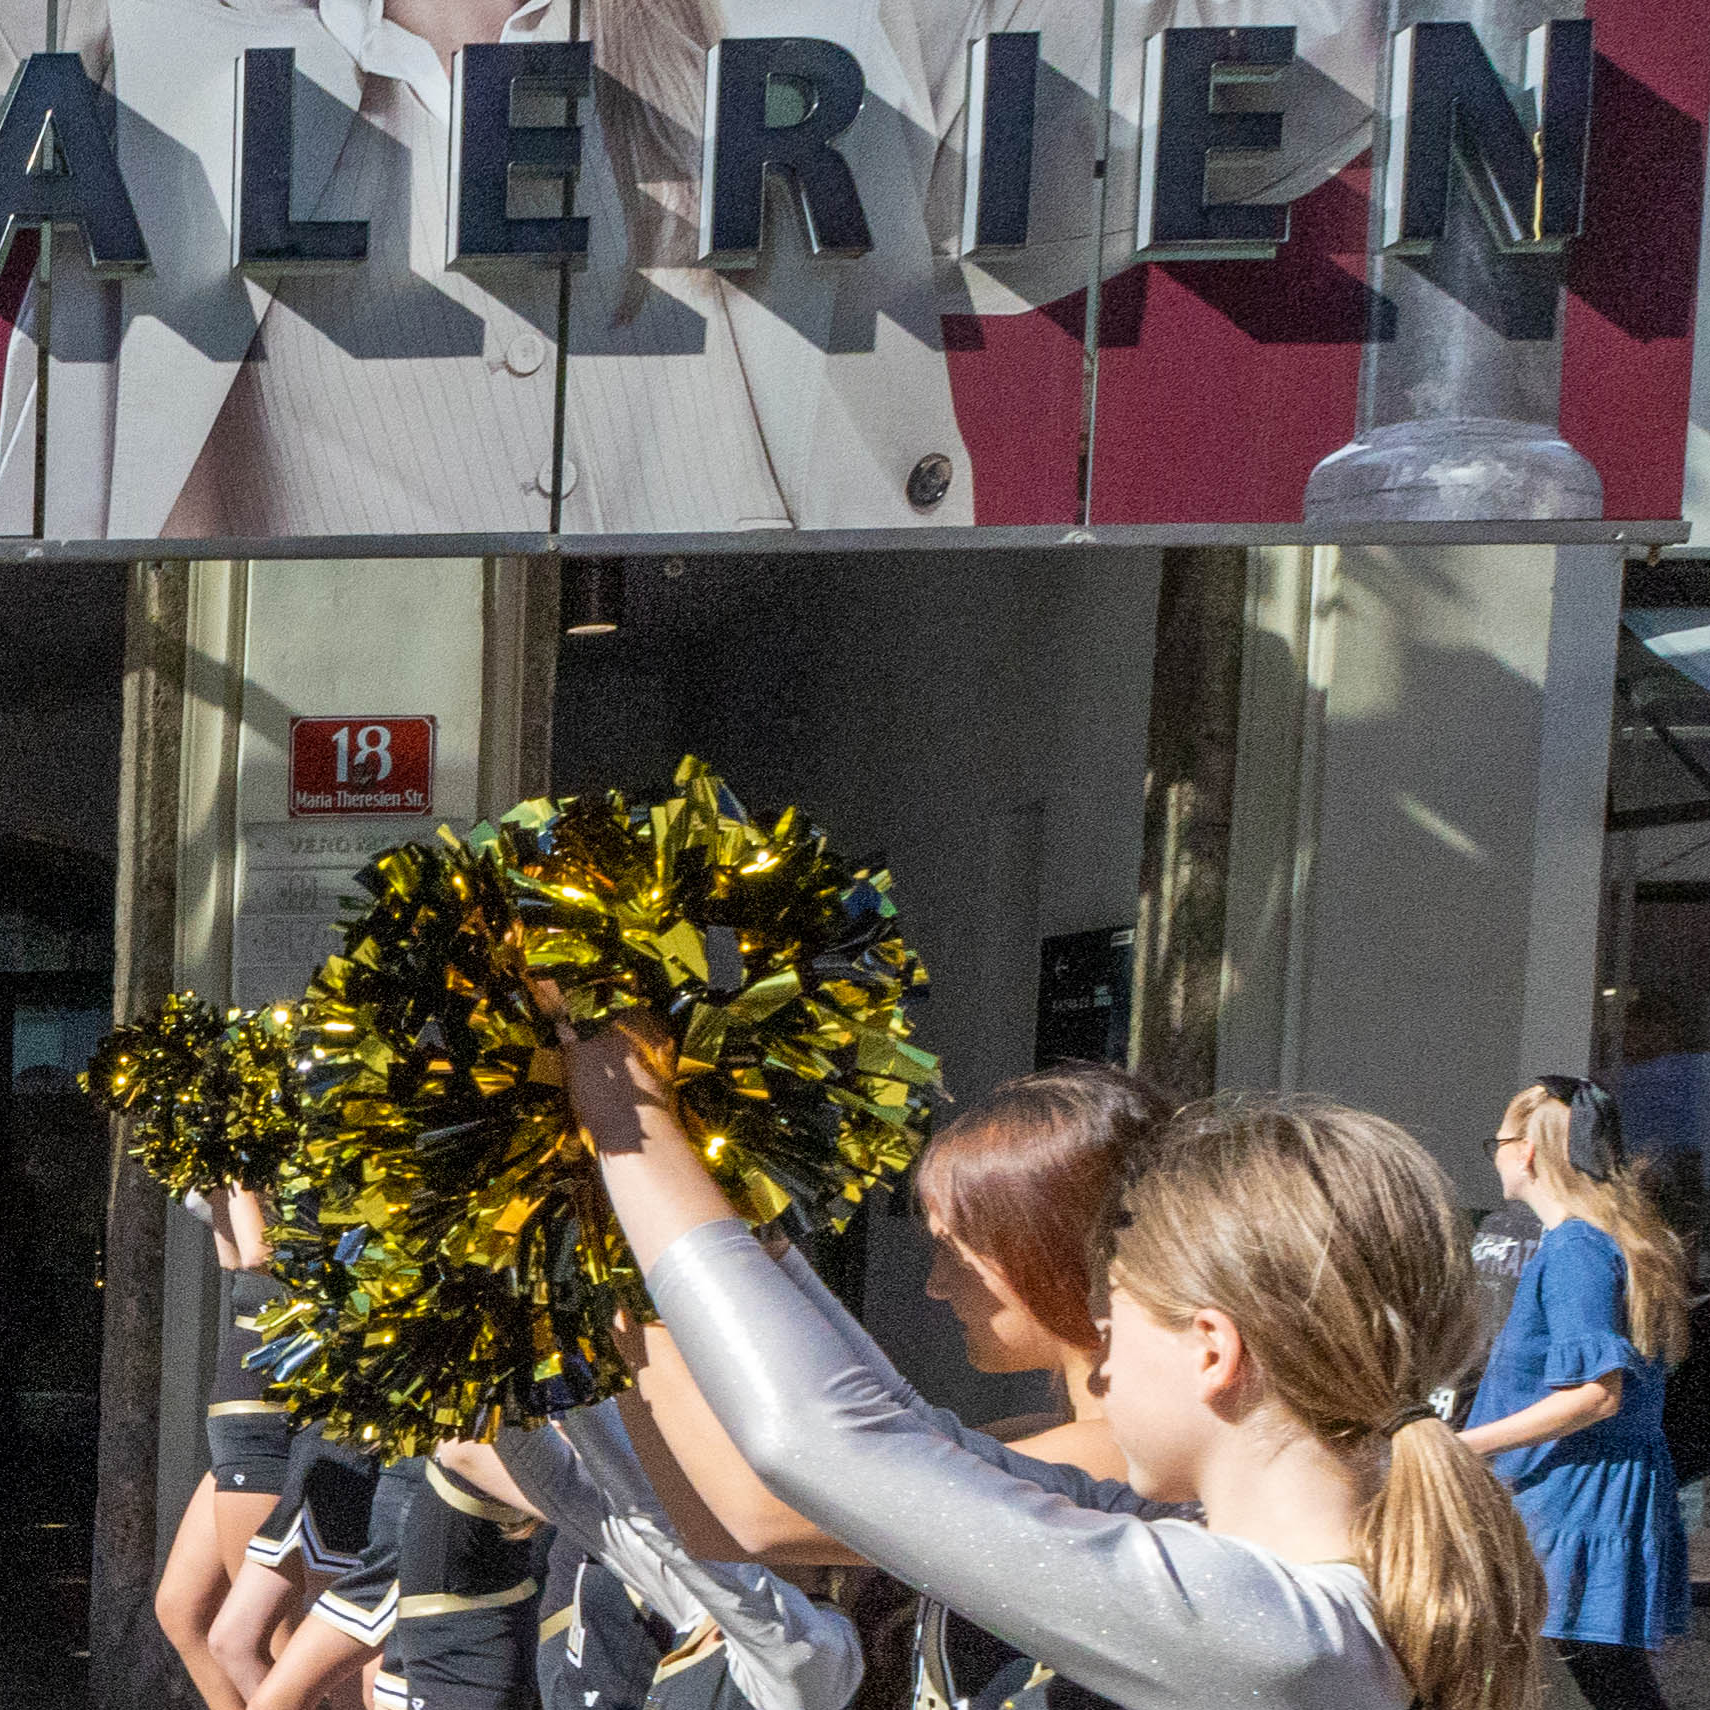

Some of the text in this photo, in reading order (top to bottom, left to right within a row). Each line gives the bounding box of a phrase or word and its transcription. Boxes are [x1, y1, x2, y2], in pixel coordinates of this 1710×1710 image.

[331, 725, 393, 783] 18
[295, 788, 425, 809] Maria Theresien Str.
